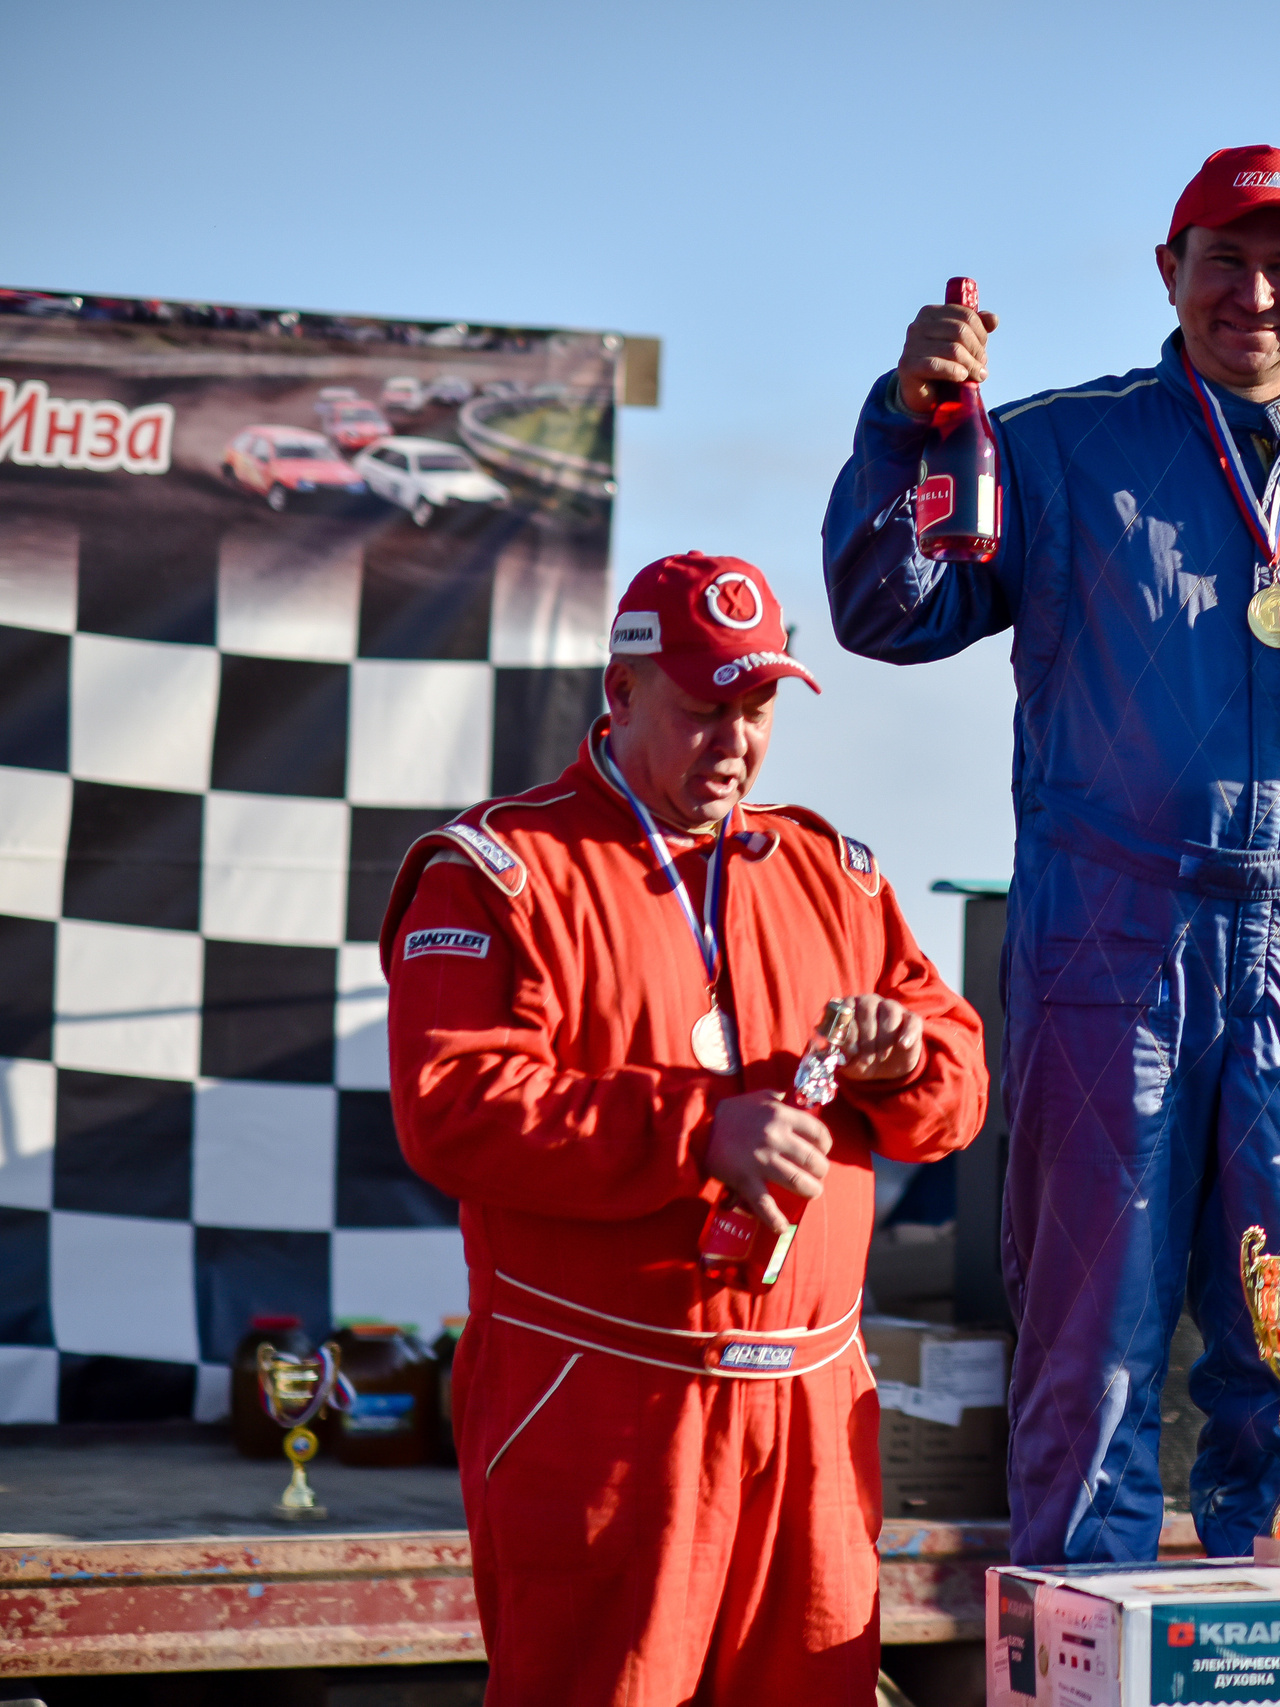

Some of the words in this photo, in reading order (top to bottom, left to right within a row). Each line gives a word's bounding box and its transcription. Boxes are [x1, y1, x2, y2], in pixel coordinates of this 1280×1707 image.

[1233, 171, 1272, 187] VAL
[0, 383, 168, 468] Инза
[918, 490, 949, 502] NELLI
[409, 932, 485, 950] SANDTLER
[724, 1346, 793, 1366] sparco
[1214, 1673, 1275, 1689] ДУХОВКА
